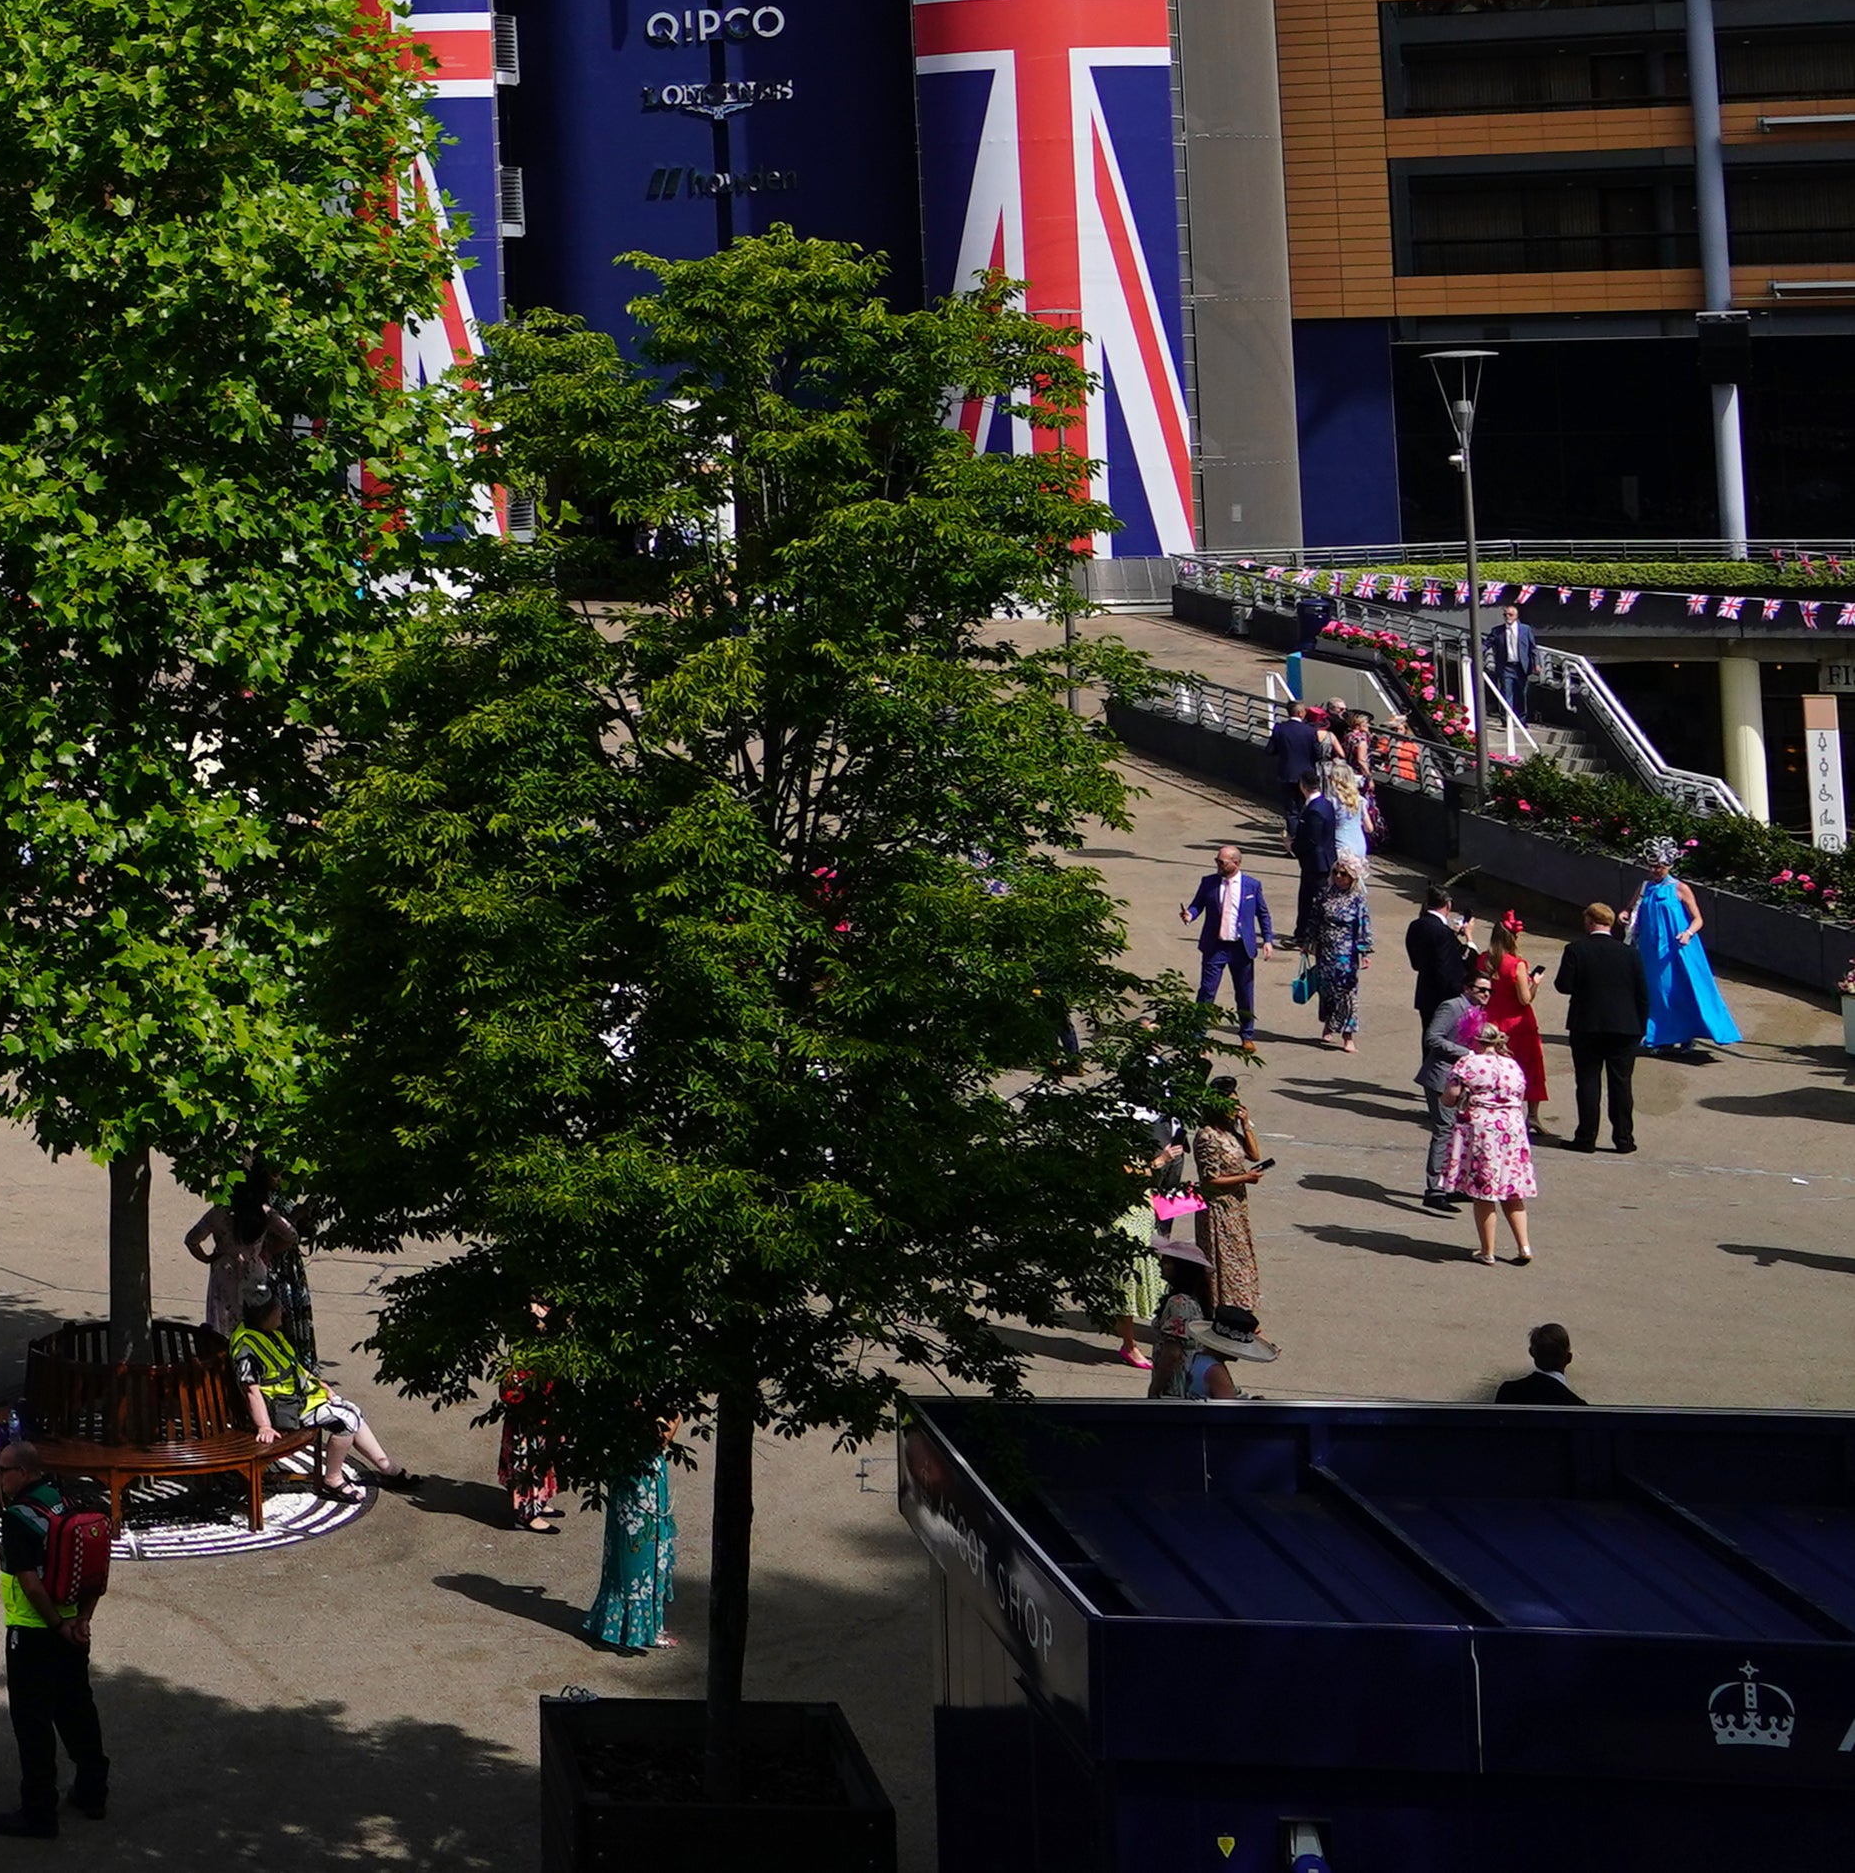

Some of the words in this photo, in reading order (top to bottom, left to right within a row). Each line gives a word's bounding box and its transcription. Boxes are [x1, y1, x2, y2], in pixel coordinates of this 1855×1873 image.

[642, 79, 794, 106] LONINES
[1826, 664, 1855, 685] FI
[938, 1493, 989, 1588] ASCOT
[996, 1561, 1053, 1663] SHOP
